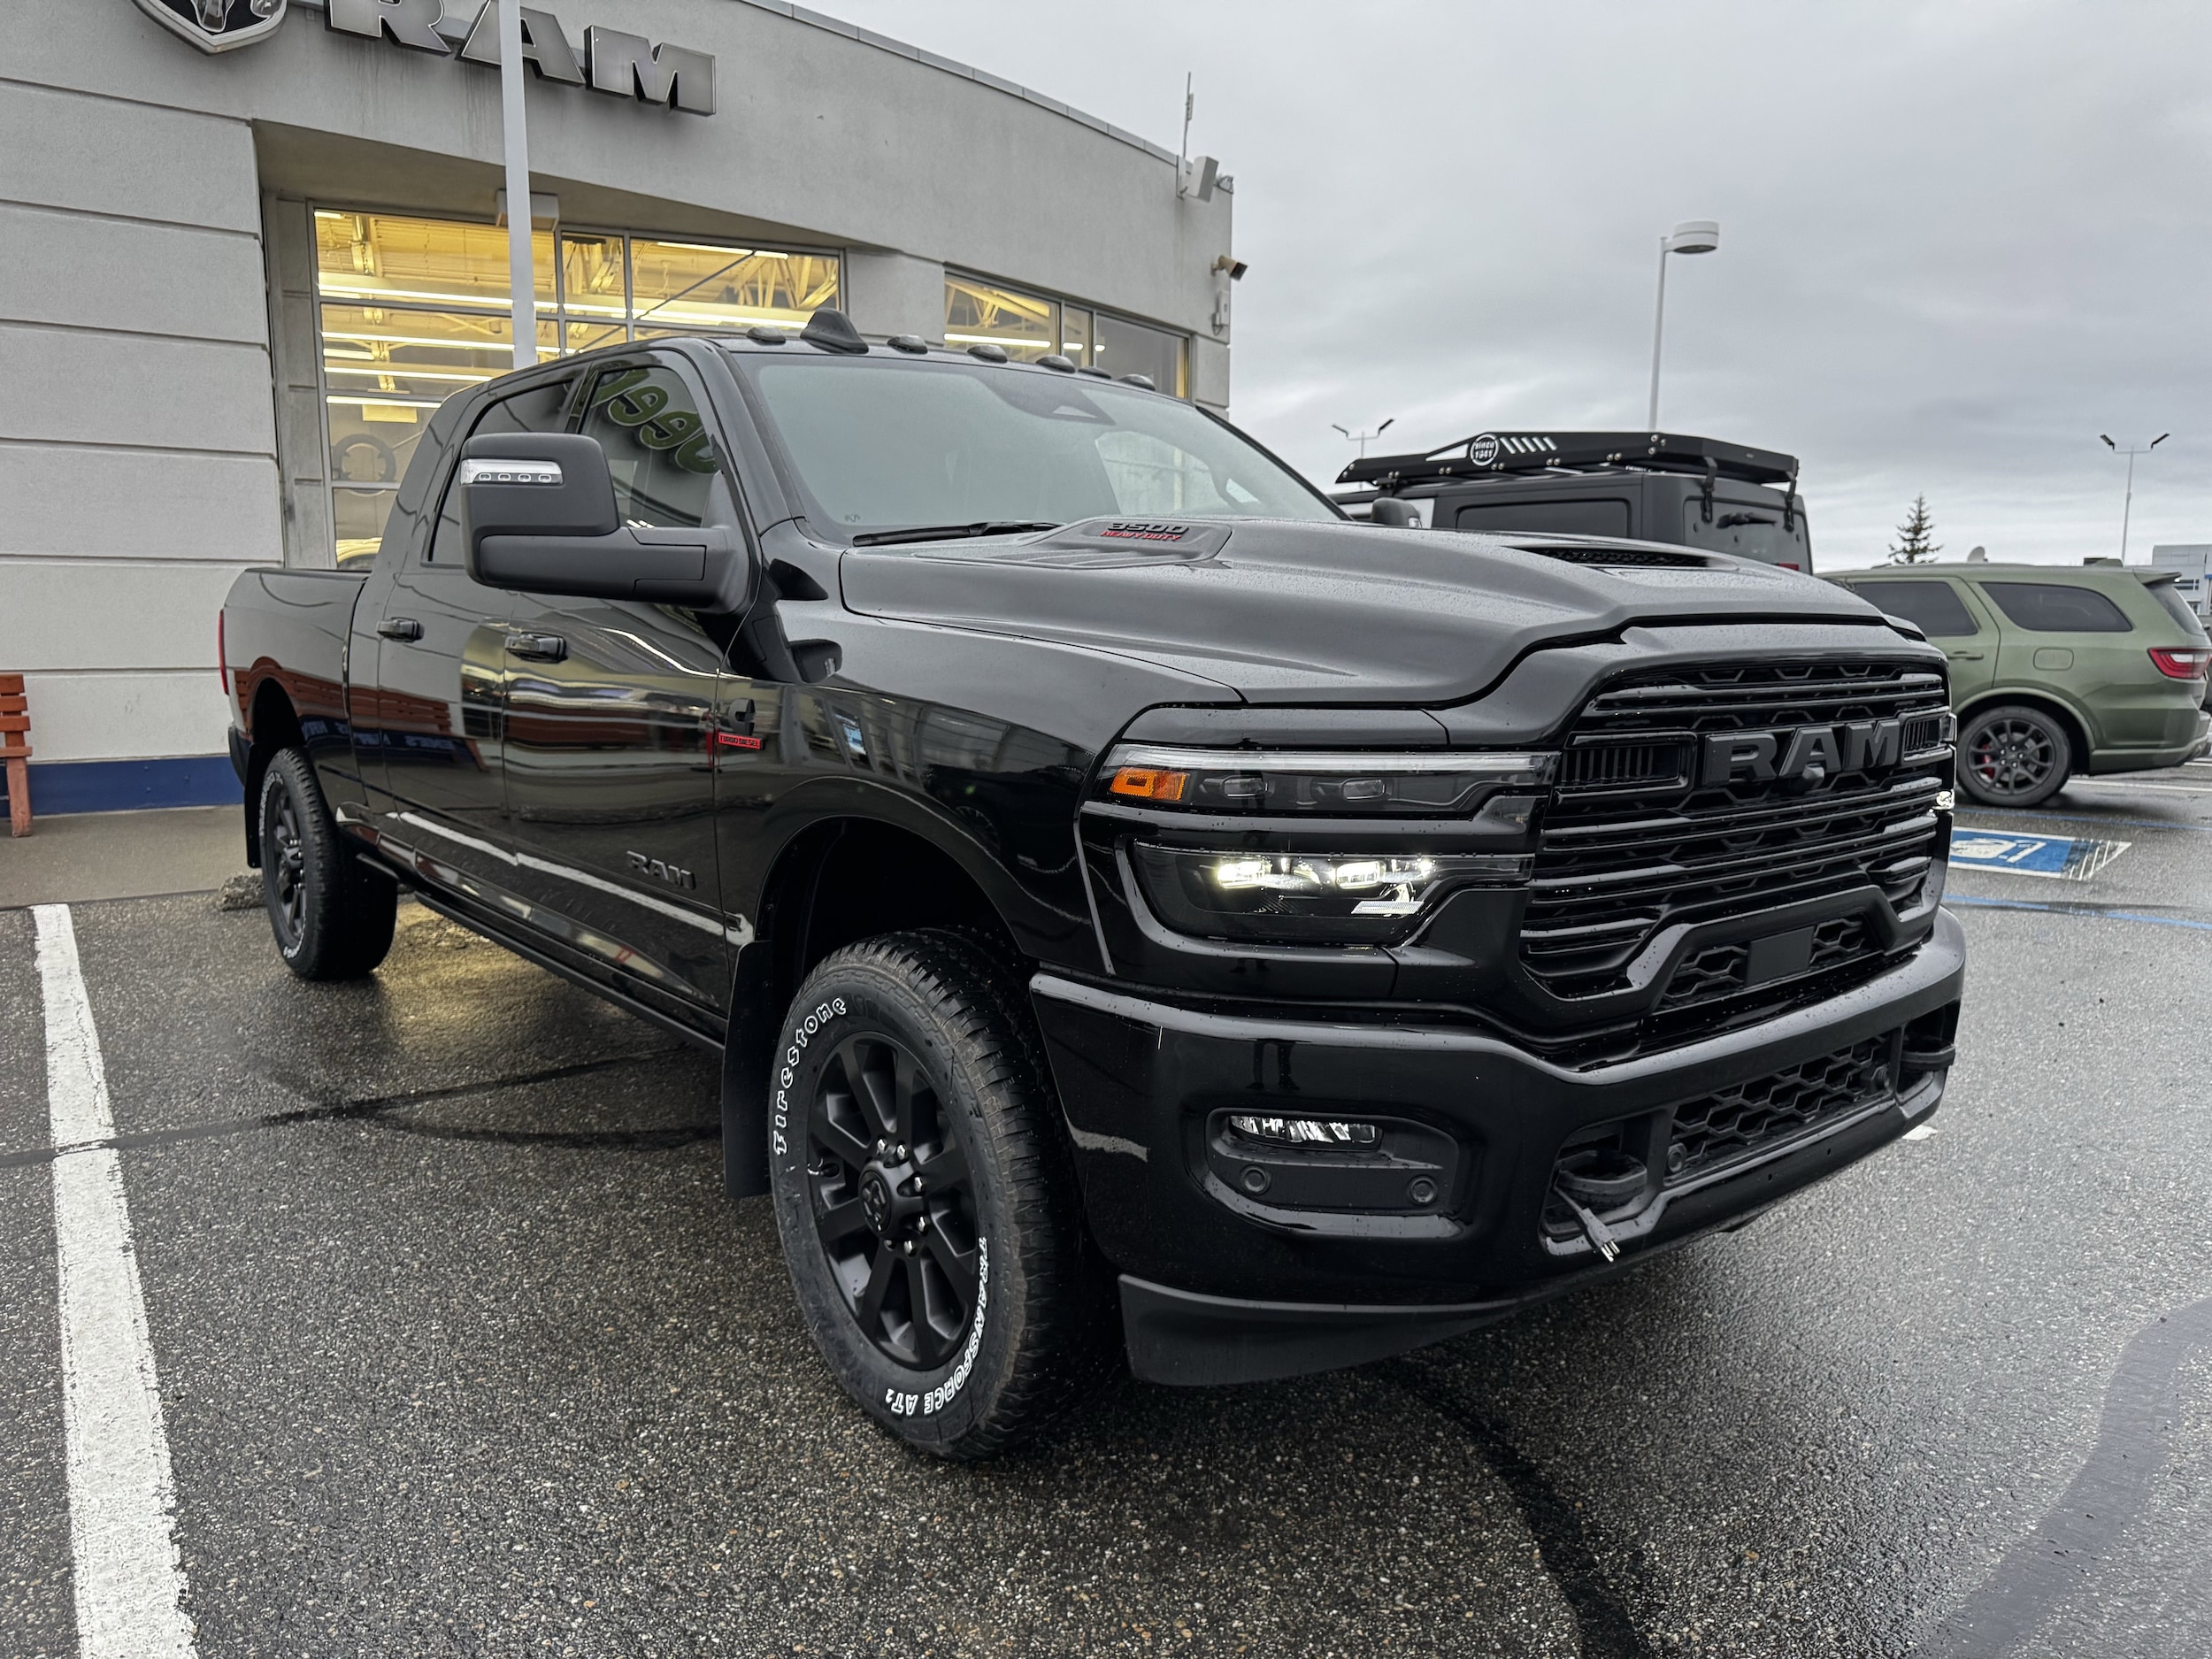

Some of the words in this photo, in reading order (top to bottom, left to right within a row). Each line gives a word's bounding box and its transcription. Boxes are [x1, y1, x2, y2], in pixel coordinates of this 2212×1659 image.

[1107, 523, 1189, 534] 3500
[1143, 533, 1182, 541] DUTY
[1701, 719, 1901, 786] RAM
[626, 850, 695, 890] RAM
[772, 997, 847, 1156] Firestone
[923, 1237, 989, 1415] TRANSFORCE
